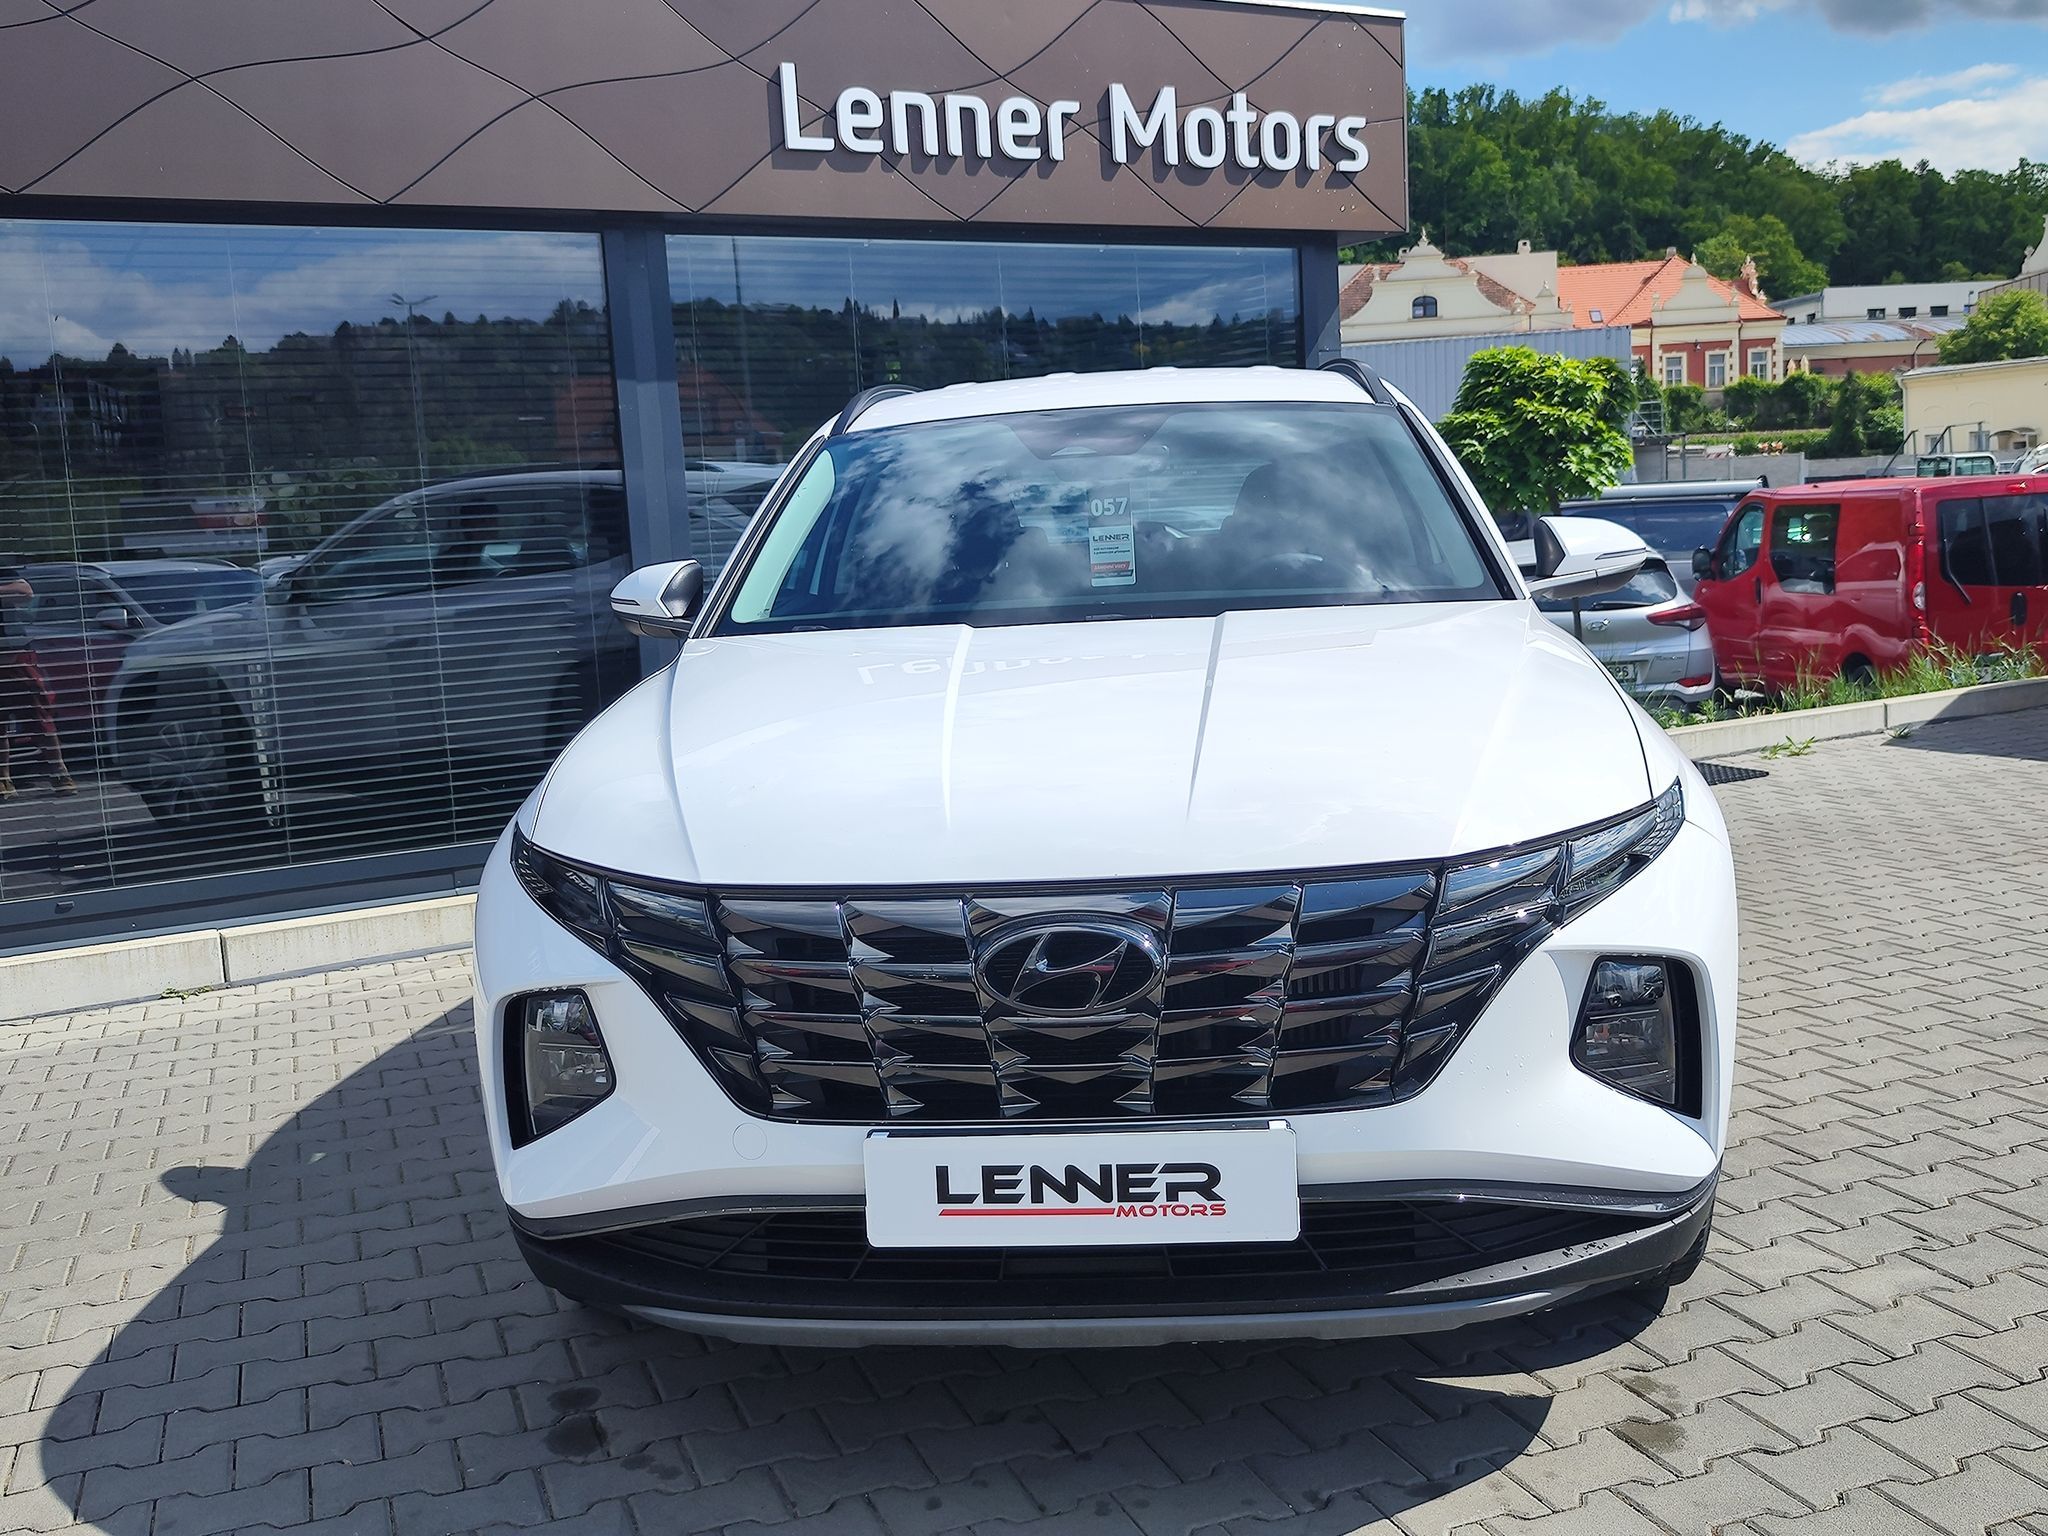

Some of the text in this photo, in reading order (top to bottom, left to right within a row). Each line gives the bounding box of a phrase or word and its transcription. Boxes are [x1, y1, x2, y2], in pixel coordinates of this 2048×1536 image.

[780, 61, 1370, 173] Lenner Motors
[1090, 498, 1128, 517] 057
[1092, 533, 1130, 542] LENNER
[935, 1162, 1227, 1205] LENNER
[1116, 1203, 1227, 1218] MOTORS
